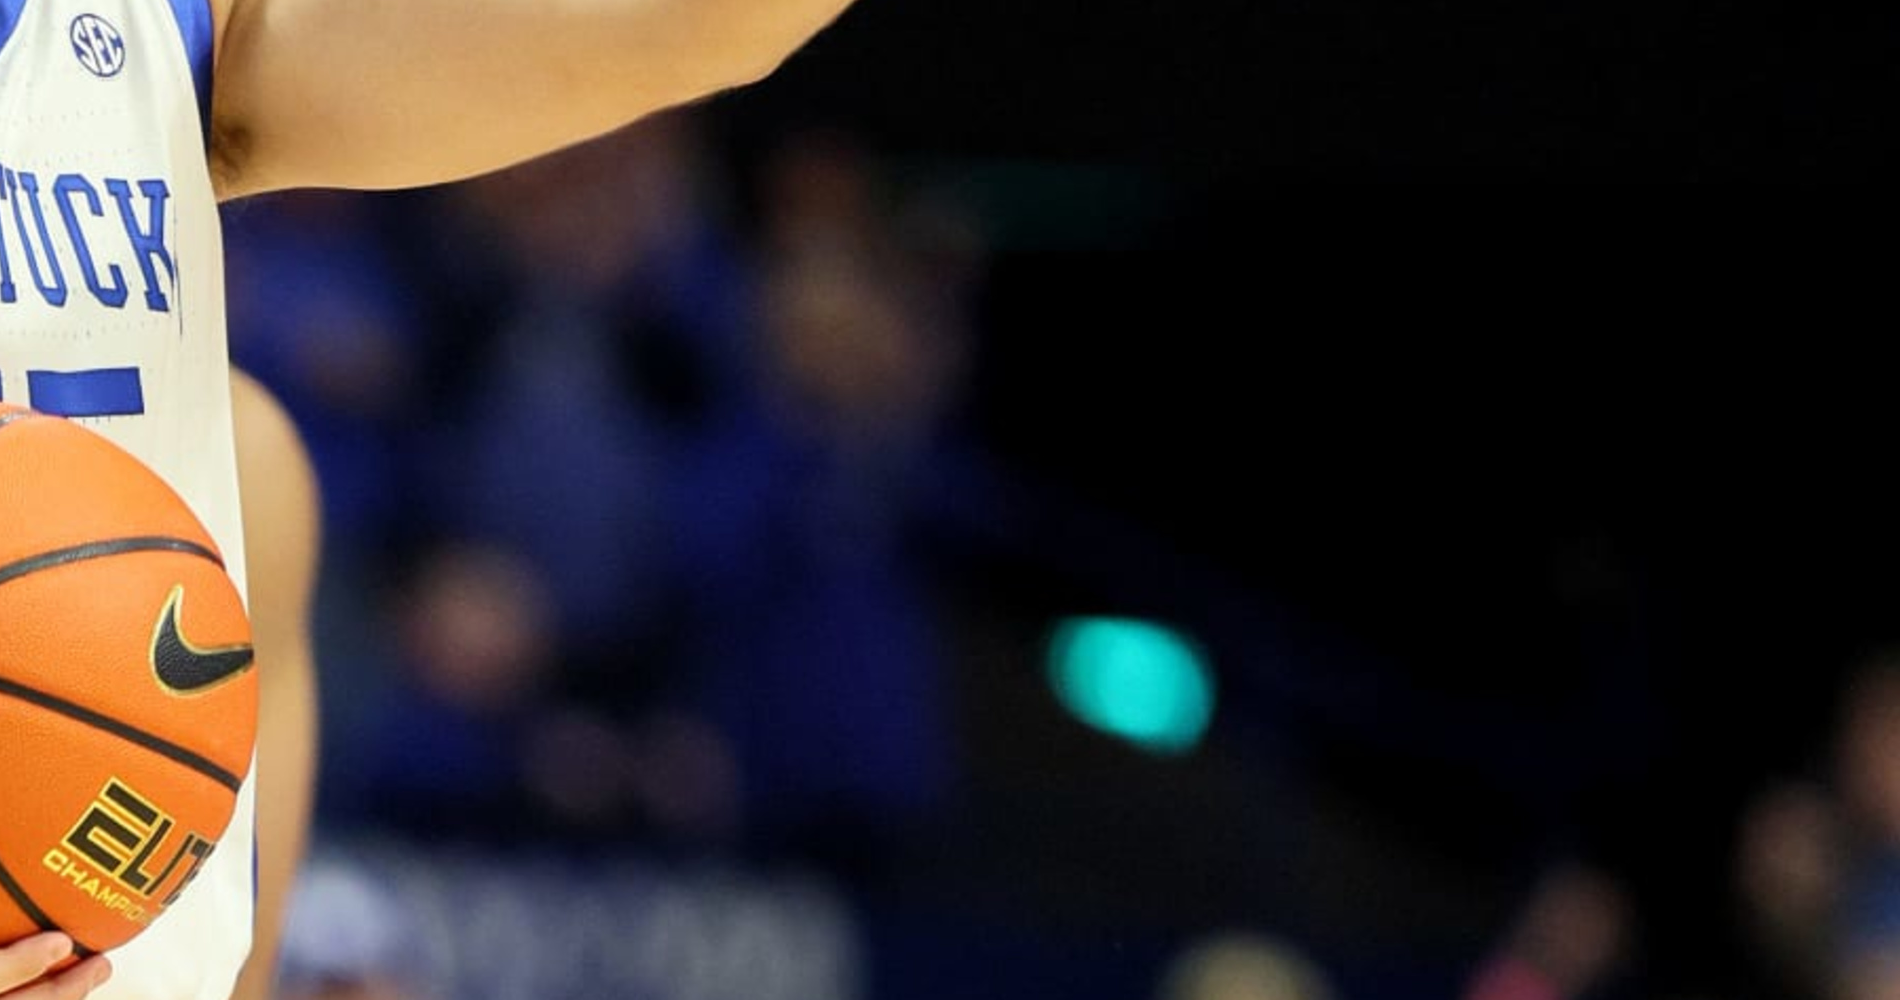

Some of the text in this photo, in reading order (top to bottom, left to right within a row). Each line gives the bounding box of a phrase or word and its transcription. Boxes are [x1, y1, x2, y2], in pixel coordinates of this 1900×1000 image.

[69, 13, 126, 77] SEC
[61, 776, 217, 907] ELIT
[42, 849, 152, 922] CHAMPIO
